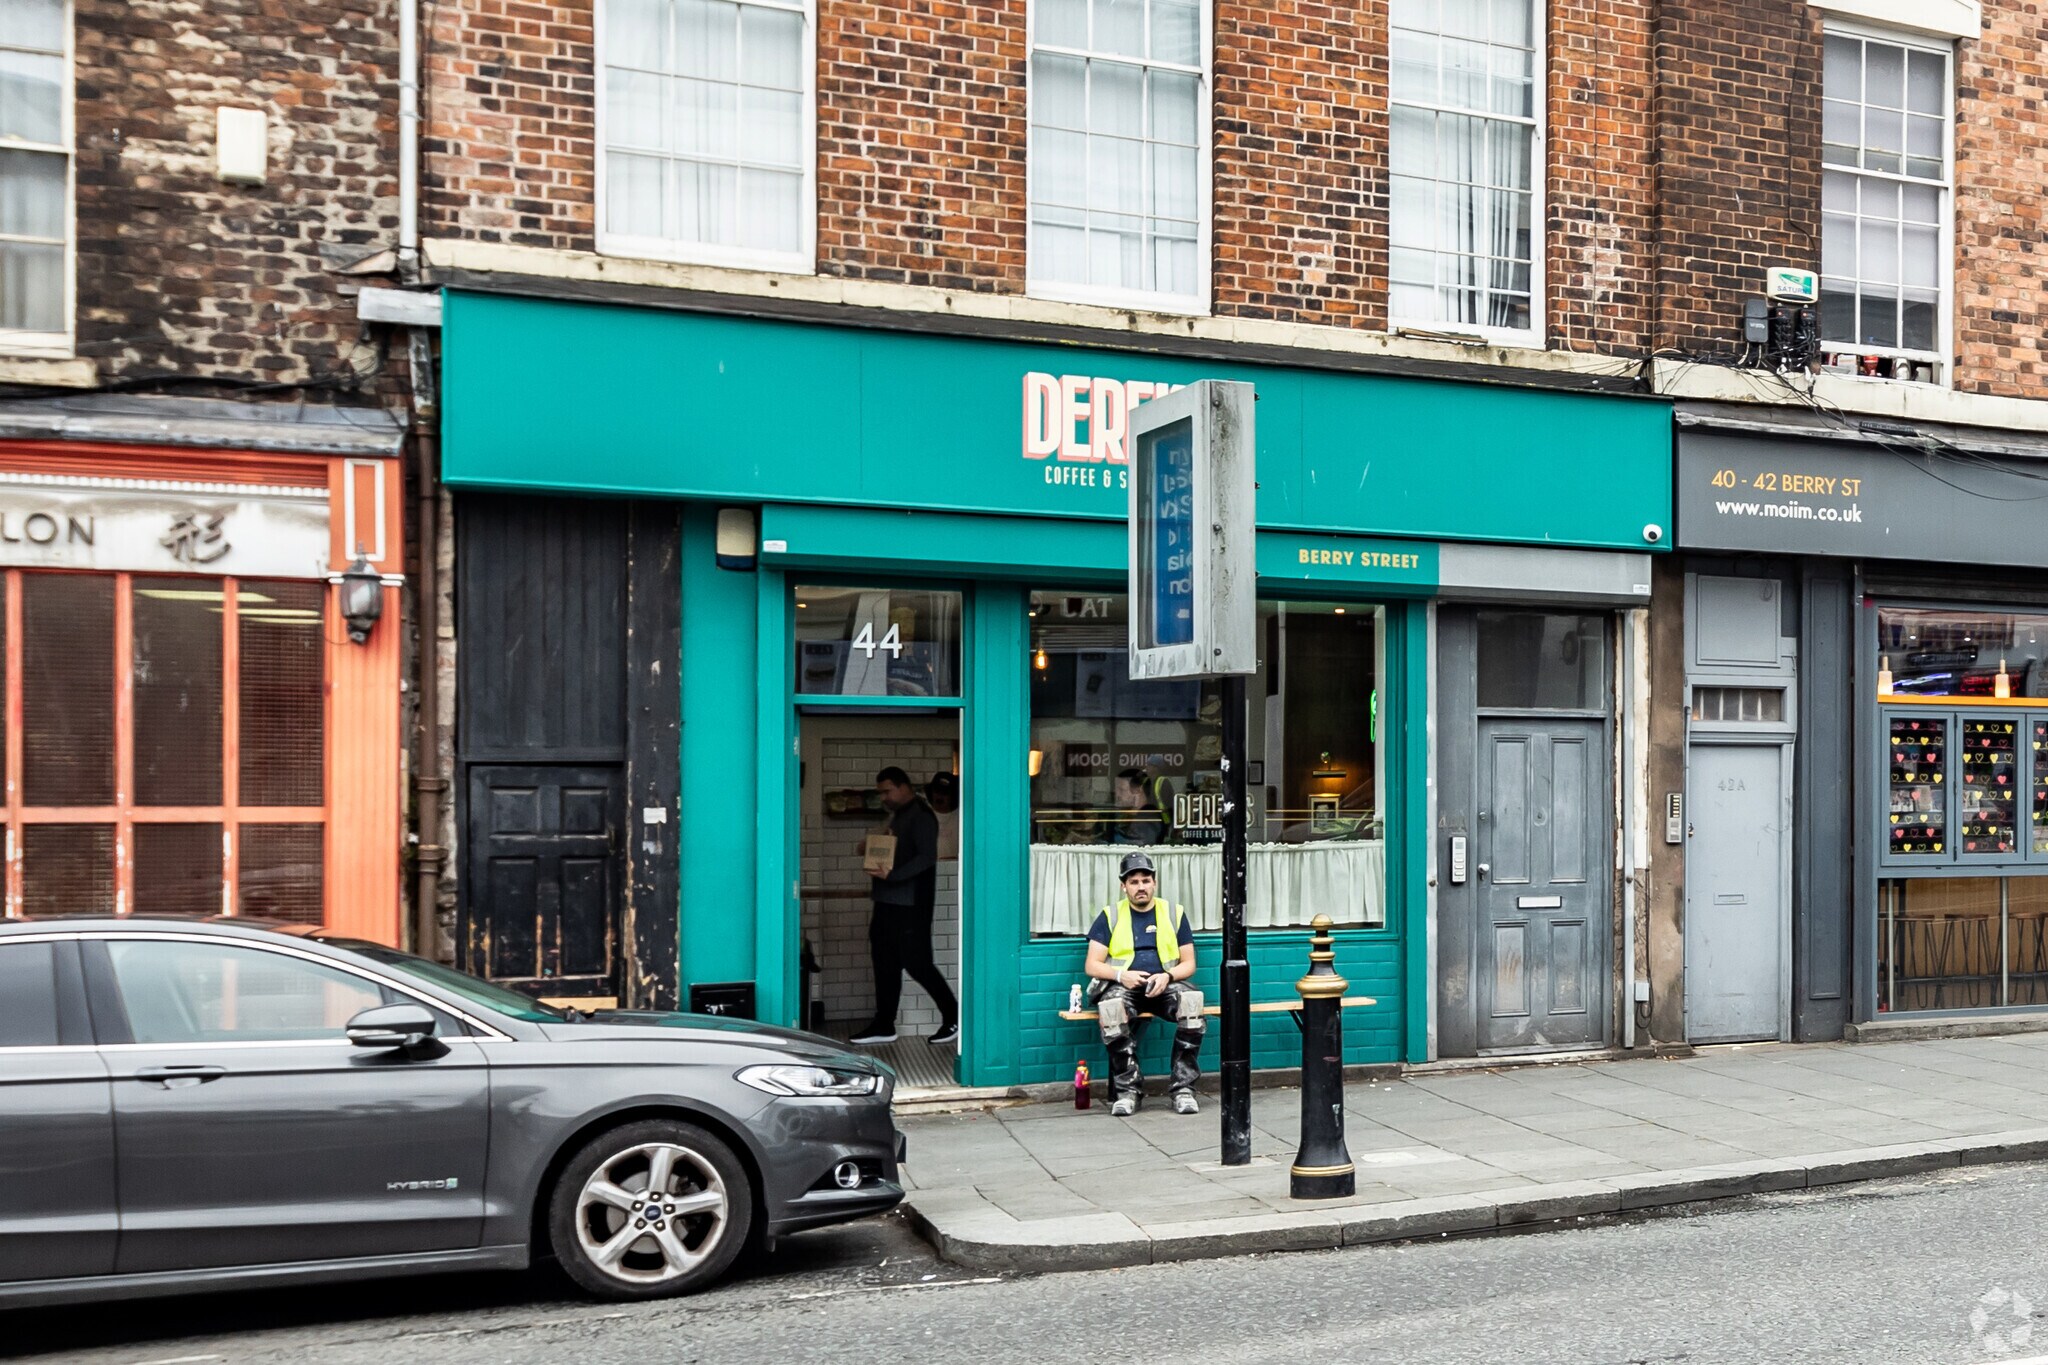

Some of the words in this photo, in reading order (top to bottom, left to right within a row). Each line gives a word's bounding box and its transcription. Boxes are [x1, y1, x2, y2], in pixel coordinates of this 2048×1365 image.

[1045, 465, 1096, 487] COFFEE
[1103, 469, 1111, 488] &
[1711, 470, 1736, 489] 40
[1753, 473, 1777, 491] 42
[1782, 474, 1837, 495] BERRY
[1841, 478, 1862, 497] ST
[1715, 500, 1862, 523] www.moiim.co.uk
[1299, 549, 1354, 566] BERRY
[1361, 552, 1419, 569] STREET
[852, 622, 903, 659] 44
[1717, 778, 1746, 792] 42A
[386, 1180, 445, 1190] HYBRID
